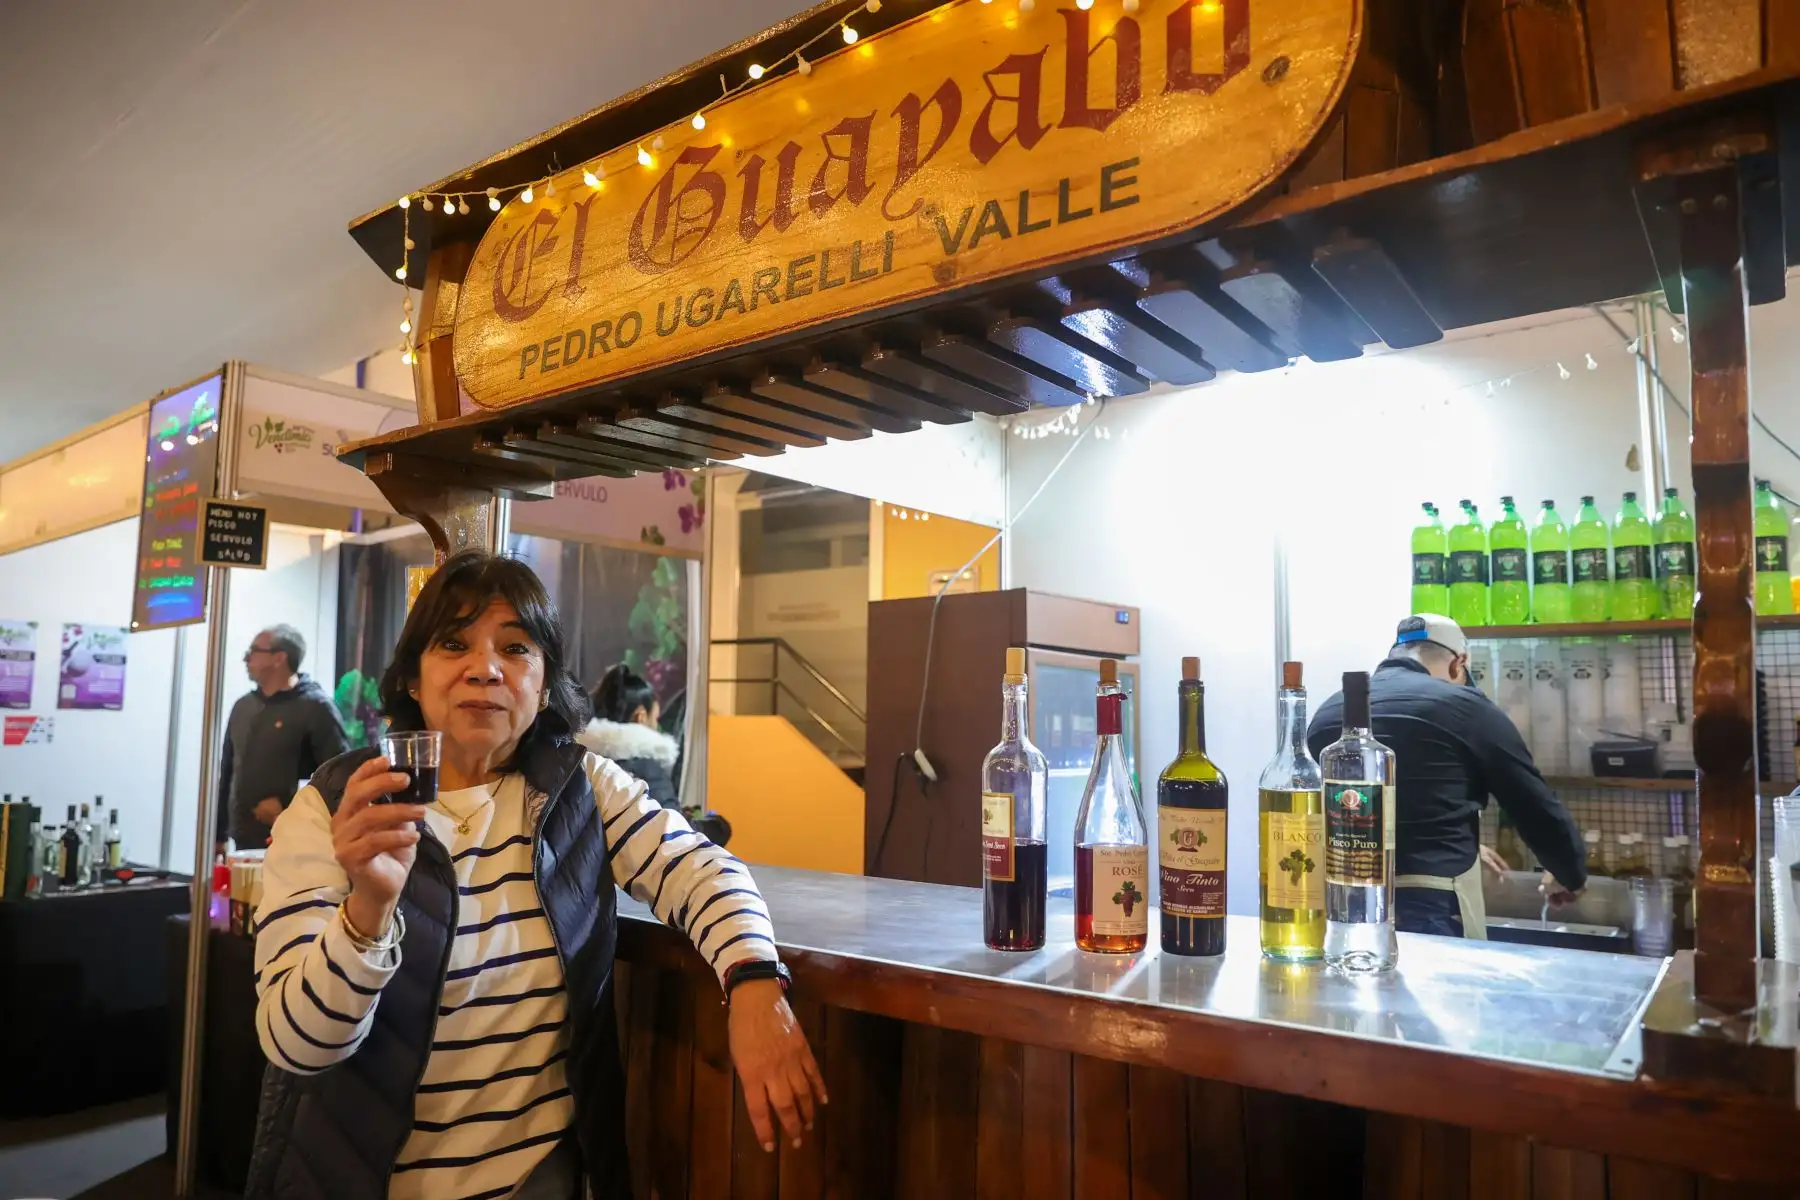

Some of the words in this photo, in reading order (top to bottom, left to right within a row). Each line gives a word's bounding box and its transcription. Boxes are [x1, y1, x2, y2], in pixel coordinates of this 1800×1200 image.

[491, 191, 599, 323] El
[628, 0, 1252, 276] Guayabo
[518, 311, 643, 380] PEDRO
[656, 230, 895, 337] UGARELLI
[932, 157, 1141, 256] VALLE
[556, 480, 608, 503] ERVULO
[208, 518, 237, 530] PISCO
[210, 532, 253, 545] SERVULO
[217, 548, 251, 562] SALUD
[1273, 830, 1322, 842] BLANCO
[1329, 836, 1350, 848] Pisco
[1353, 840, 1378, 849] Puro
[1161, 870, 1180, 884] Vino
[1186, 873, 1219, 886] Tinto
